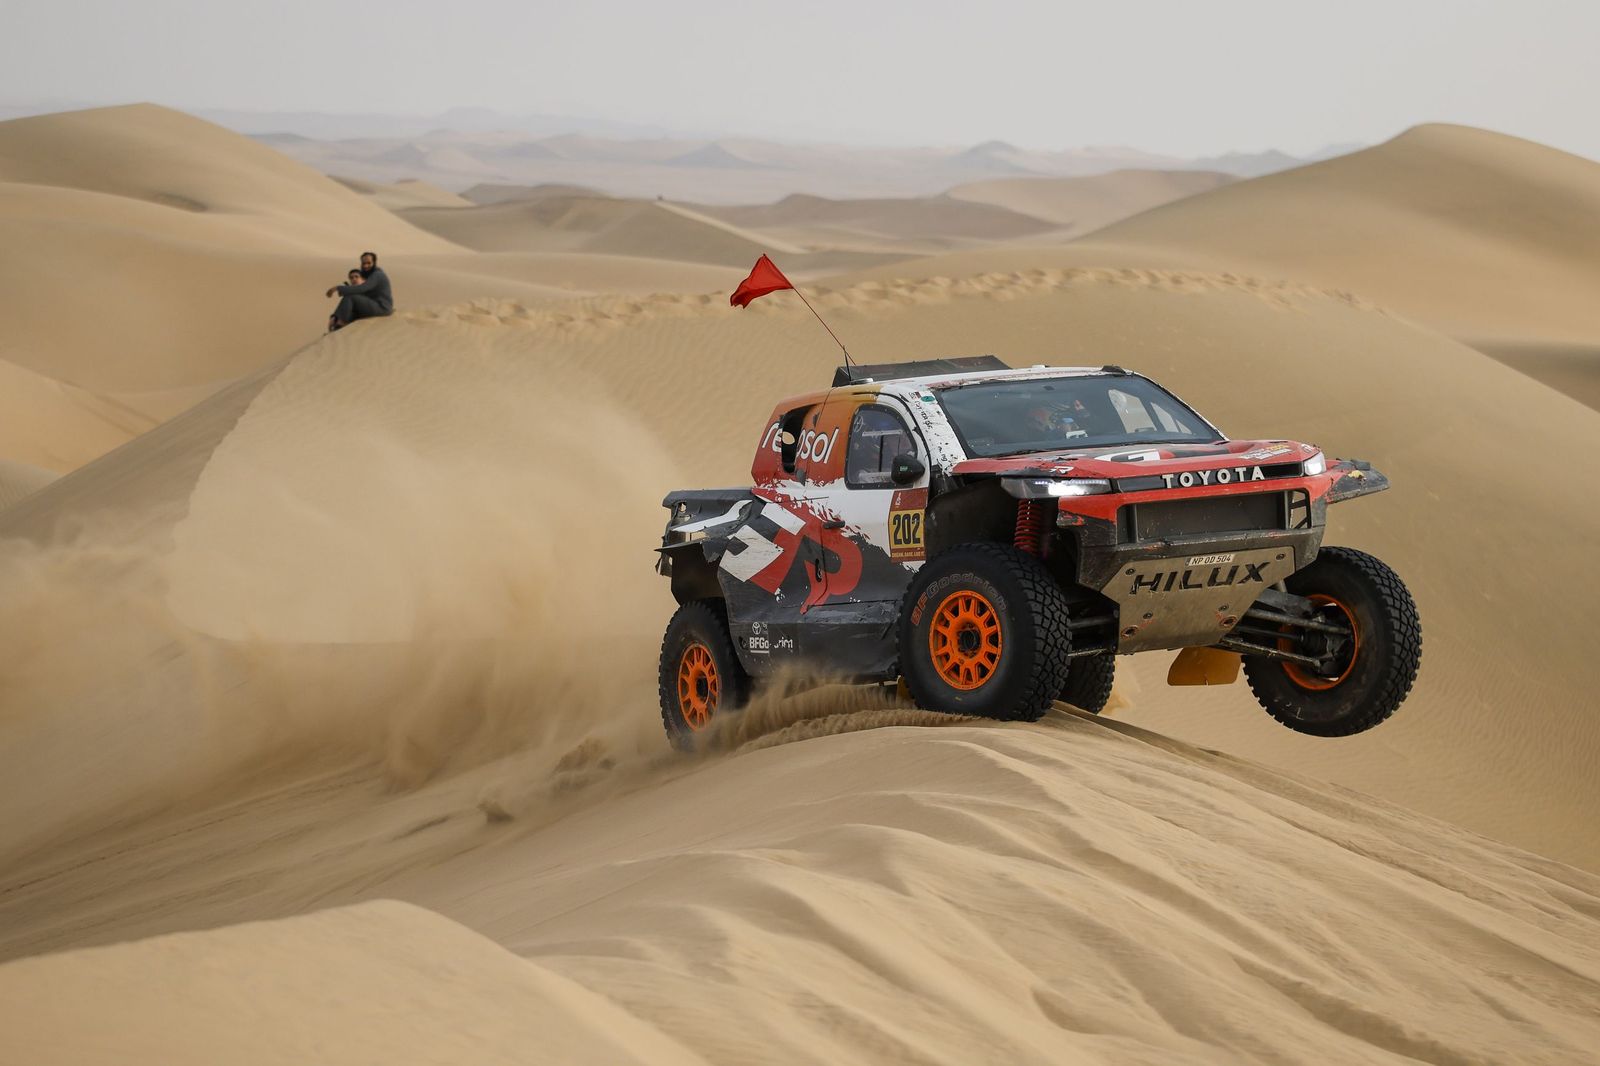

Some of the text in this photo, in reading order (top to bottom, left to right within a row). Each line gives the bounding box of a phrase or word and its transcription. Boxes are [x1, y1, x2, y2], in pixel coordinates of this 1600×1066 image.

[1162, 466, 1265, 488] TOYOTA
[893, 513, 921, 545] 202
[1191, 557, 1204, 565] NP
[1216, 554, 1232, 563] 504
[1129, 561, 1270, 595] HILUX
